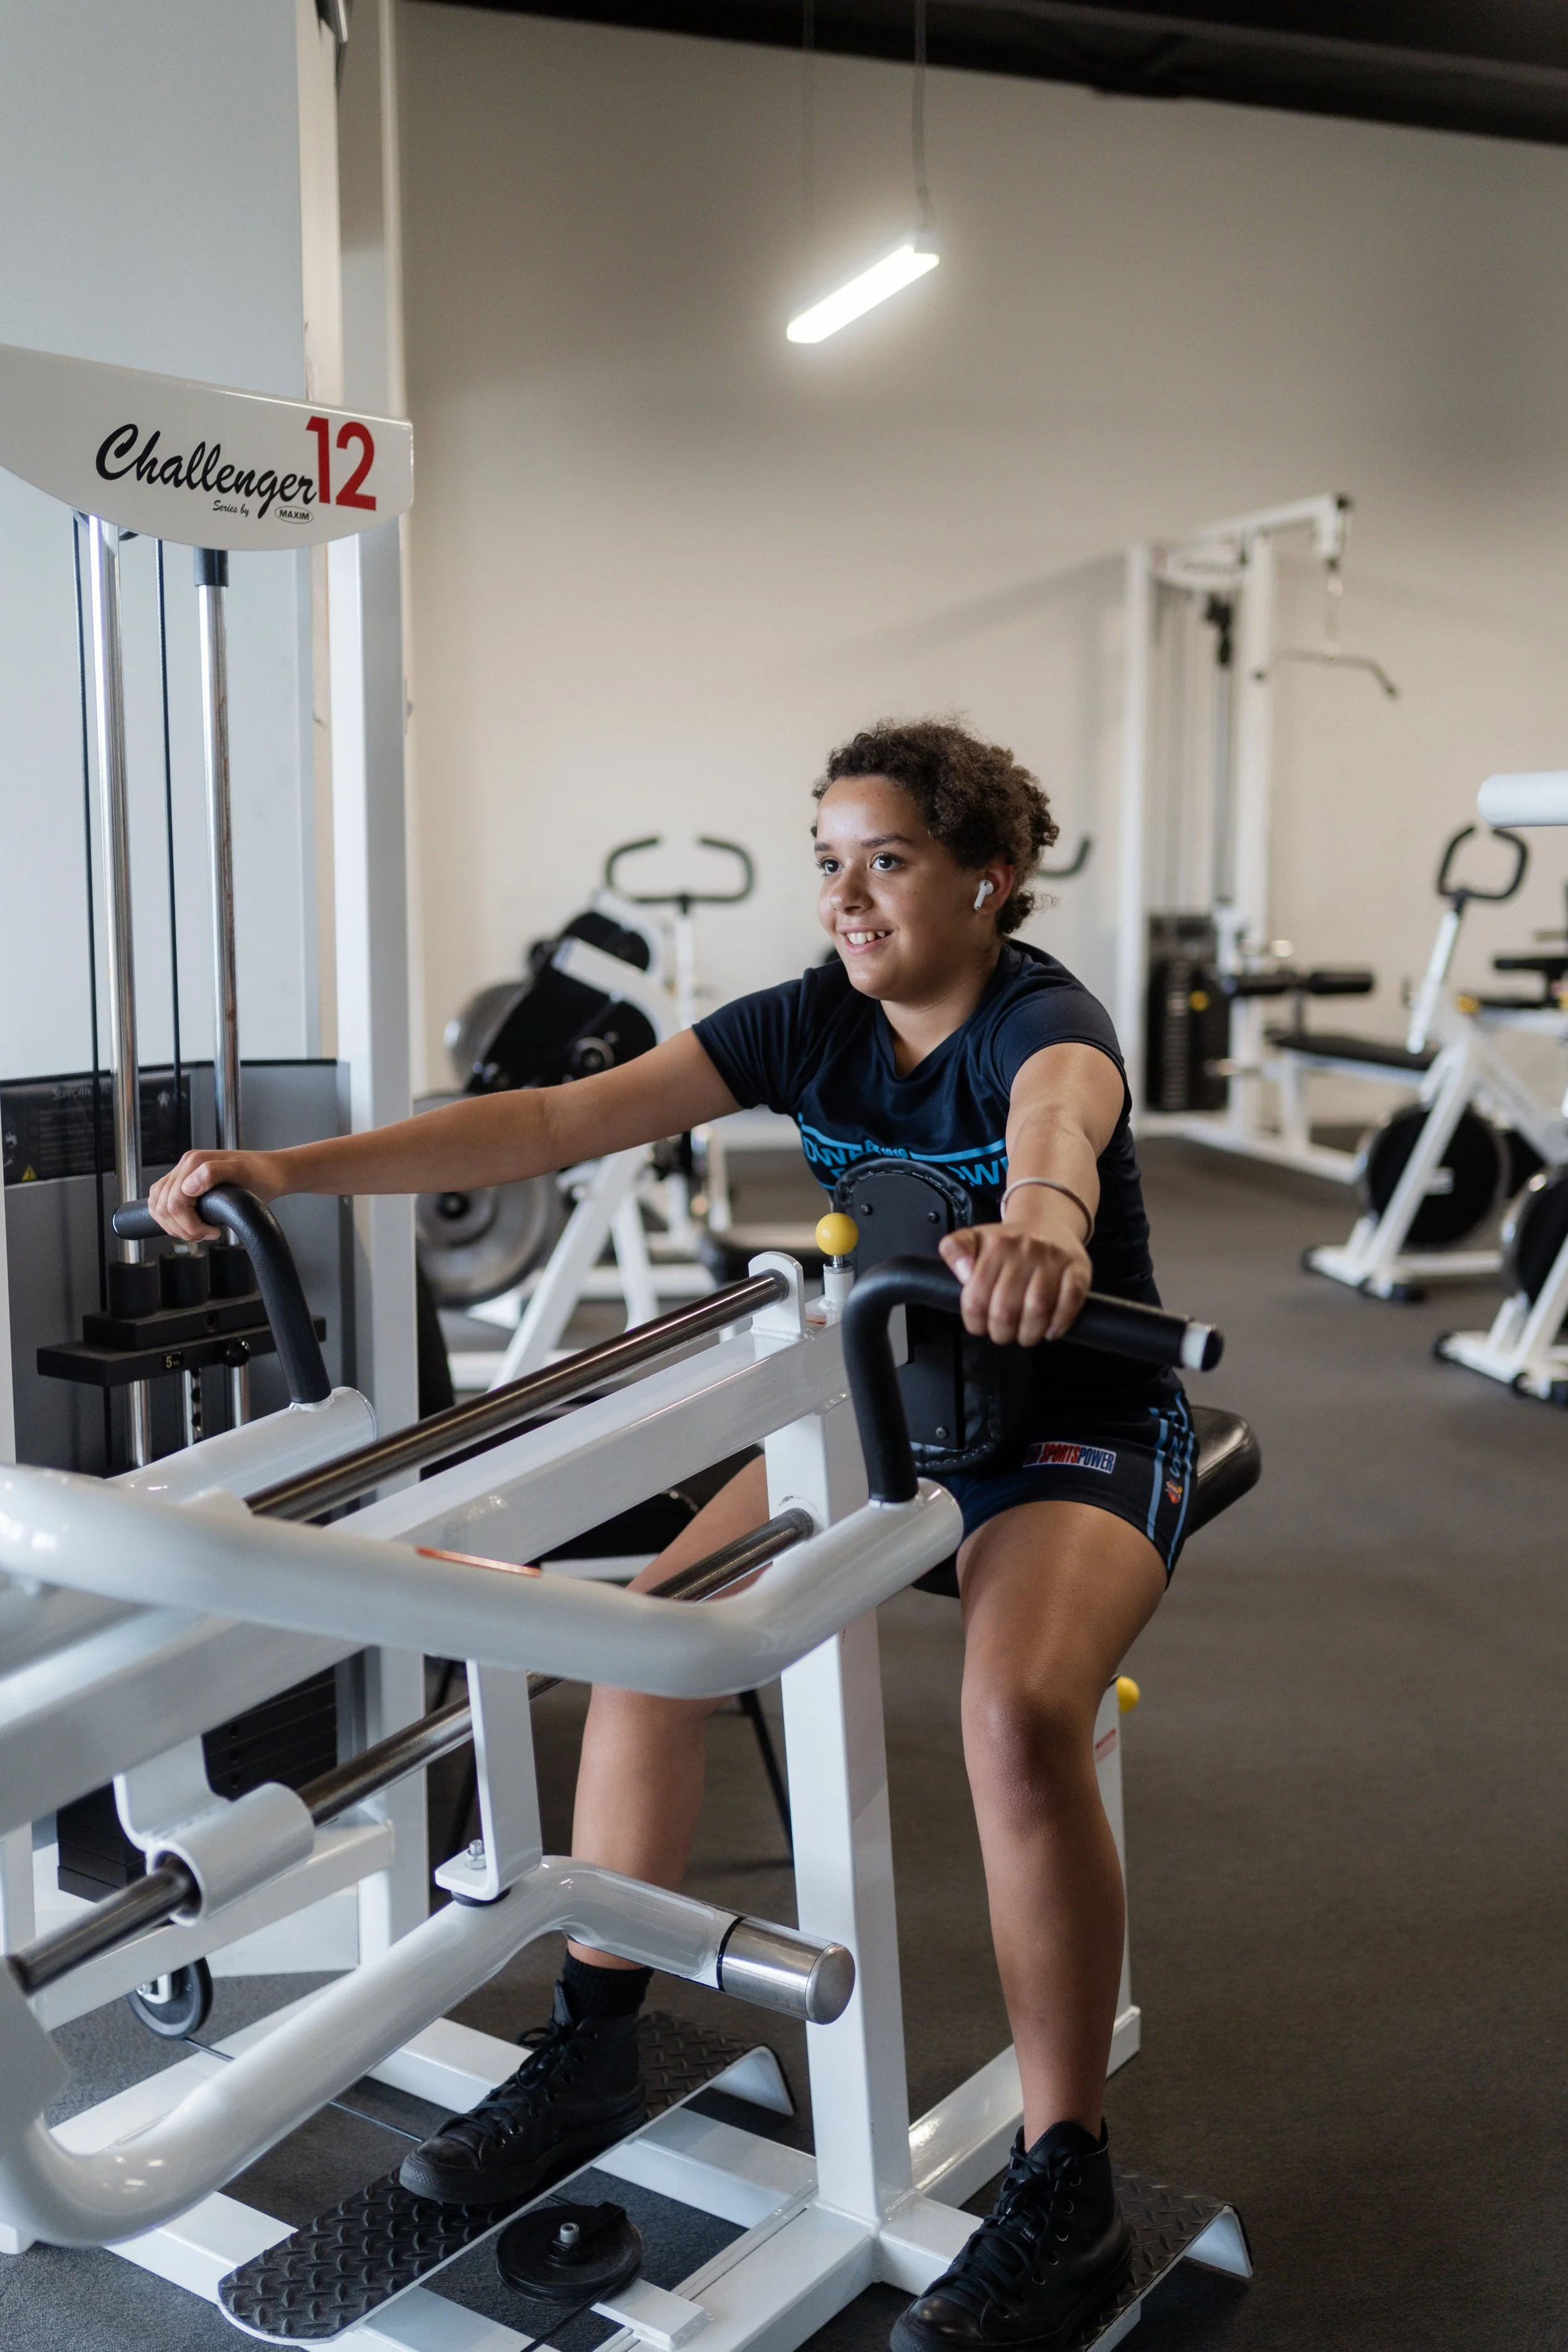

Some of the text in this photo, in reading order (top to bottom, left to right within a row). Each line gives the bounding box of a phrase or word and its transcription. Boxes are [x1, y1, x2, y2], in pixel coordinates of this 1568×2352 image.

[95, 415, 377, 519] Challenger 12
[212, 500, 310, 520] Series by MAXIM
[1038, 1443, 1115, 1472] SPORTSPOWER
